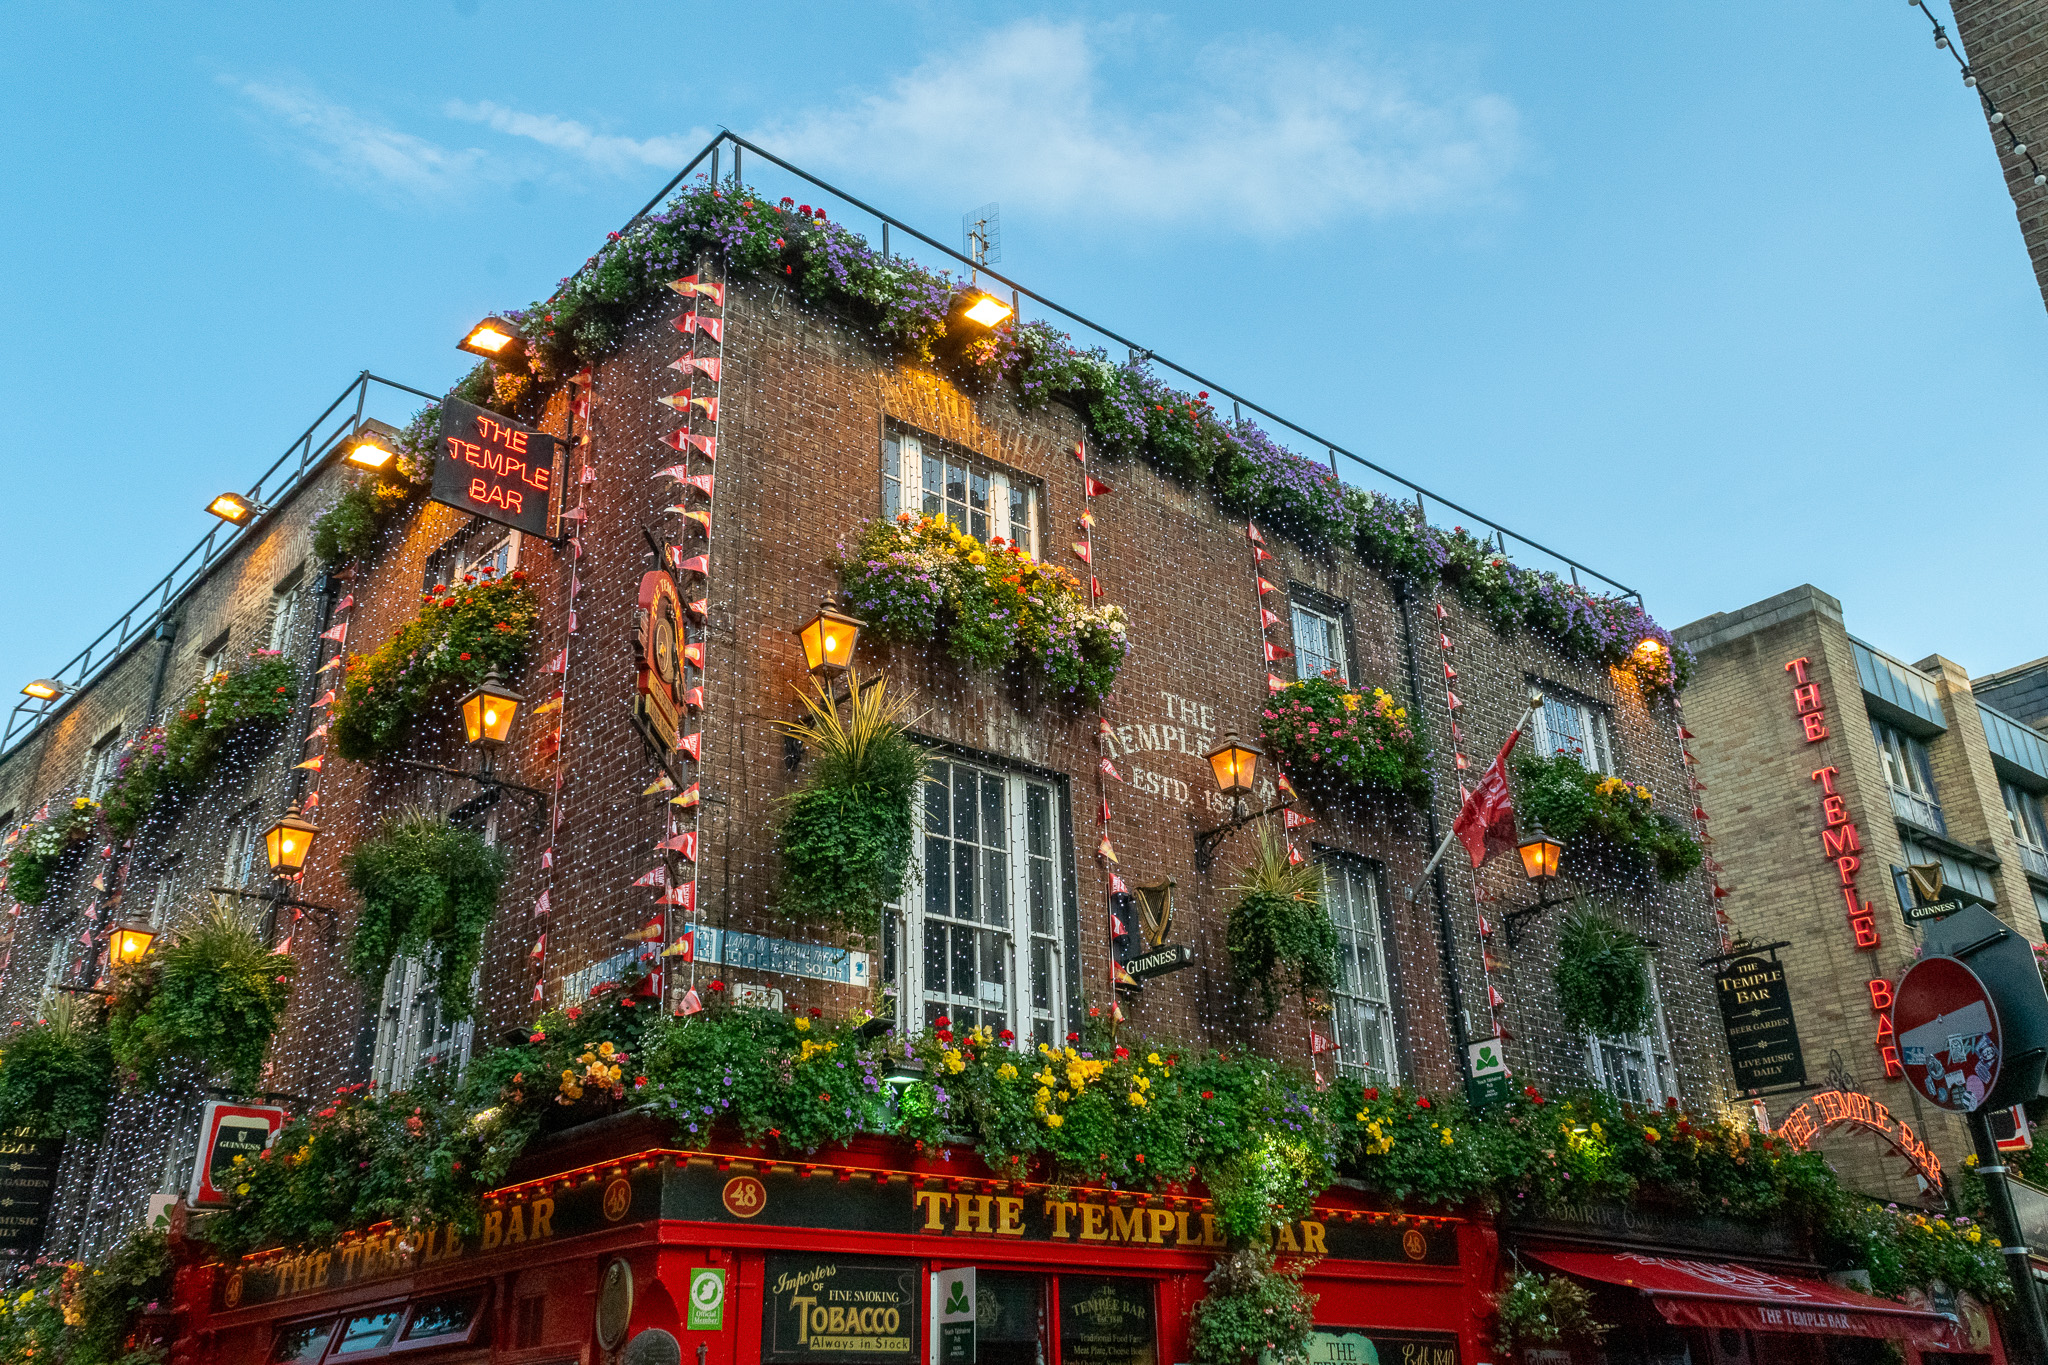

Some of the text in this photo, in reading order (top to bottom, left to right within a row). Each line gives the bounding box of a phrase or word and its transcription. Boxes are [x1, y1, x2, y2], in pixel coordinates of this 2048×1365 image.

[476, 415, 529, 454] THE
[447, 436, 551, 492] TEMPLE
[469, 477, 523, 514] BAR
[1160, 690, 1216, 733] THE
[1101, 723, 1213, 760] TEMPLE
[1785, 656, 1903, 1077] THE TEMPLE BAR
[1910, 901, 1956, 918] GUINNESS
[805, 962, 842, 978] SOUTH
[1125, 948, 1177, 975] GUINNESS
[1736, 962, 1759, 974] THE
[1718, 970, 1783, 992] TEMPLE
[1736, 988, 1771, 1005] BAR
[1729, 1017, 1790, 1035] BEER GARDEN
[1738, 1052, 1795, 1069] LIVE MUSIC
[1753, 1065, 1783, 1077] DAILY
[219, 1140, 261, 1151] GUINNESS
[1778, 1090, 1943, 1188] THE TEMPLE BAR
[4, 1178, 50, 1188] GARDEN
[0, 1216, 39, 1226] MUSIC
[730, 1181, 757, 1207] 48
[915, 1190, 1027, 1237] THE
[1044, 1200, 1228, 1247] TEMPLE
[1406, 1234, 1422, 1254] 48
[0, 1228, 20, 1237] ILY
[275, 1251, 332, 1297] THE
[483, 1197, 555, 1251] BAR
[607, 1187, 626, 1213] 48
[772, 1263, 837, 1296] Importers
[812, 1282, 824, 1292] OF
[829, 1289, 900, 1303] FINE SMOKING
[695, 1310, 717, 1318] Official
[1071, 1298, 1146, 1320] TEMPLE BAR
[1757, 1307, 1783, 1325] THE
[1784, 1308, 1828, 1328] TEMPLE
[1827, 1314, 1850, 1329] BAR
[694, 1316, 718, 1325] Member
[789, 1295, 900, 1345] TOBACCO
[811, 1336, 908, 1350] Always in Stock
[1326, 1342, 1357, 1362] THE
[1433, 1348, 1455, 1365] 1840
